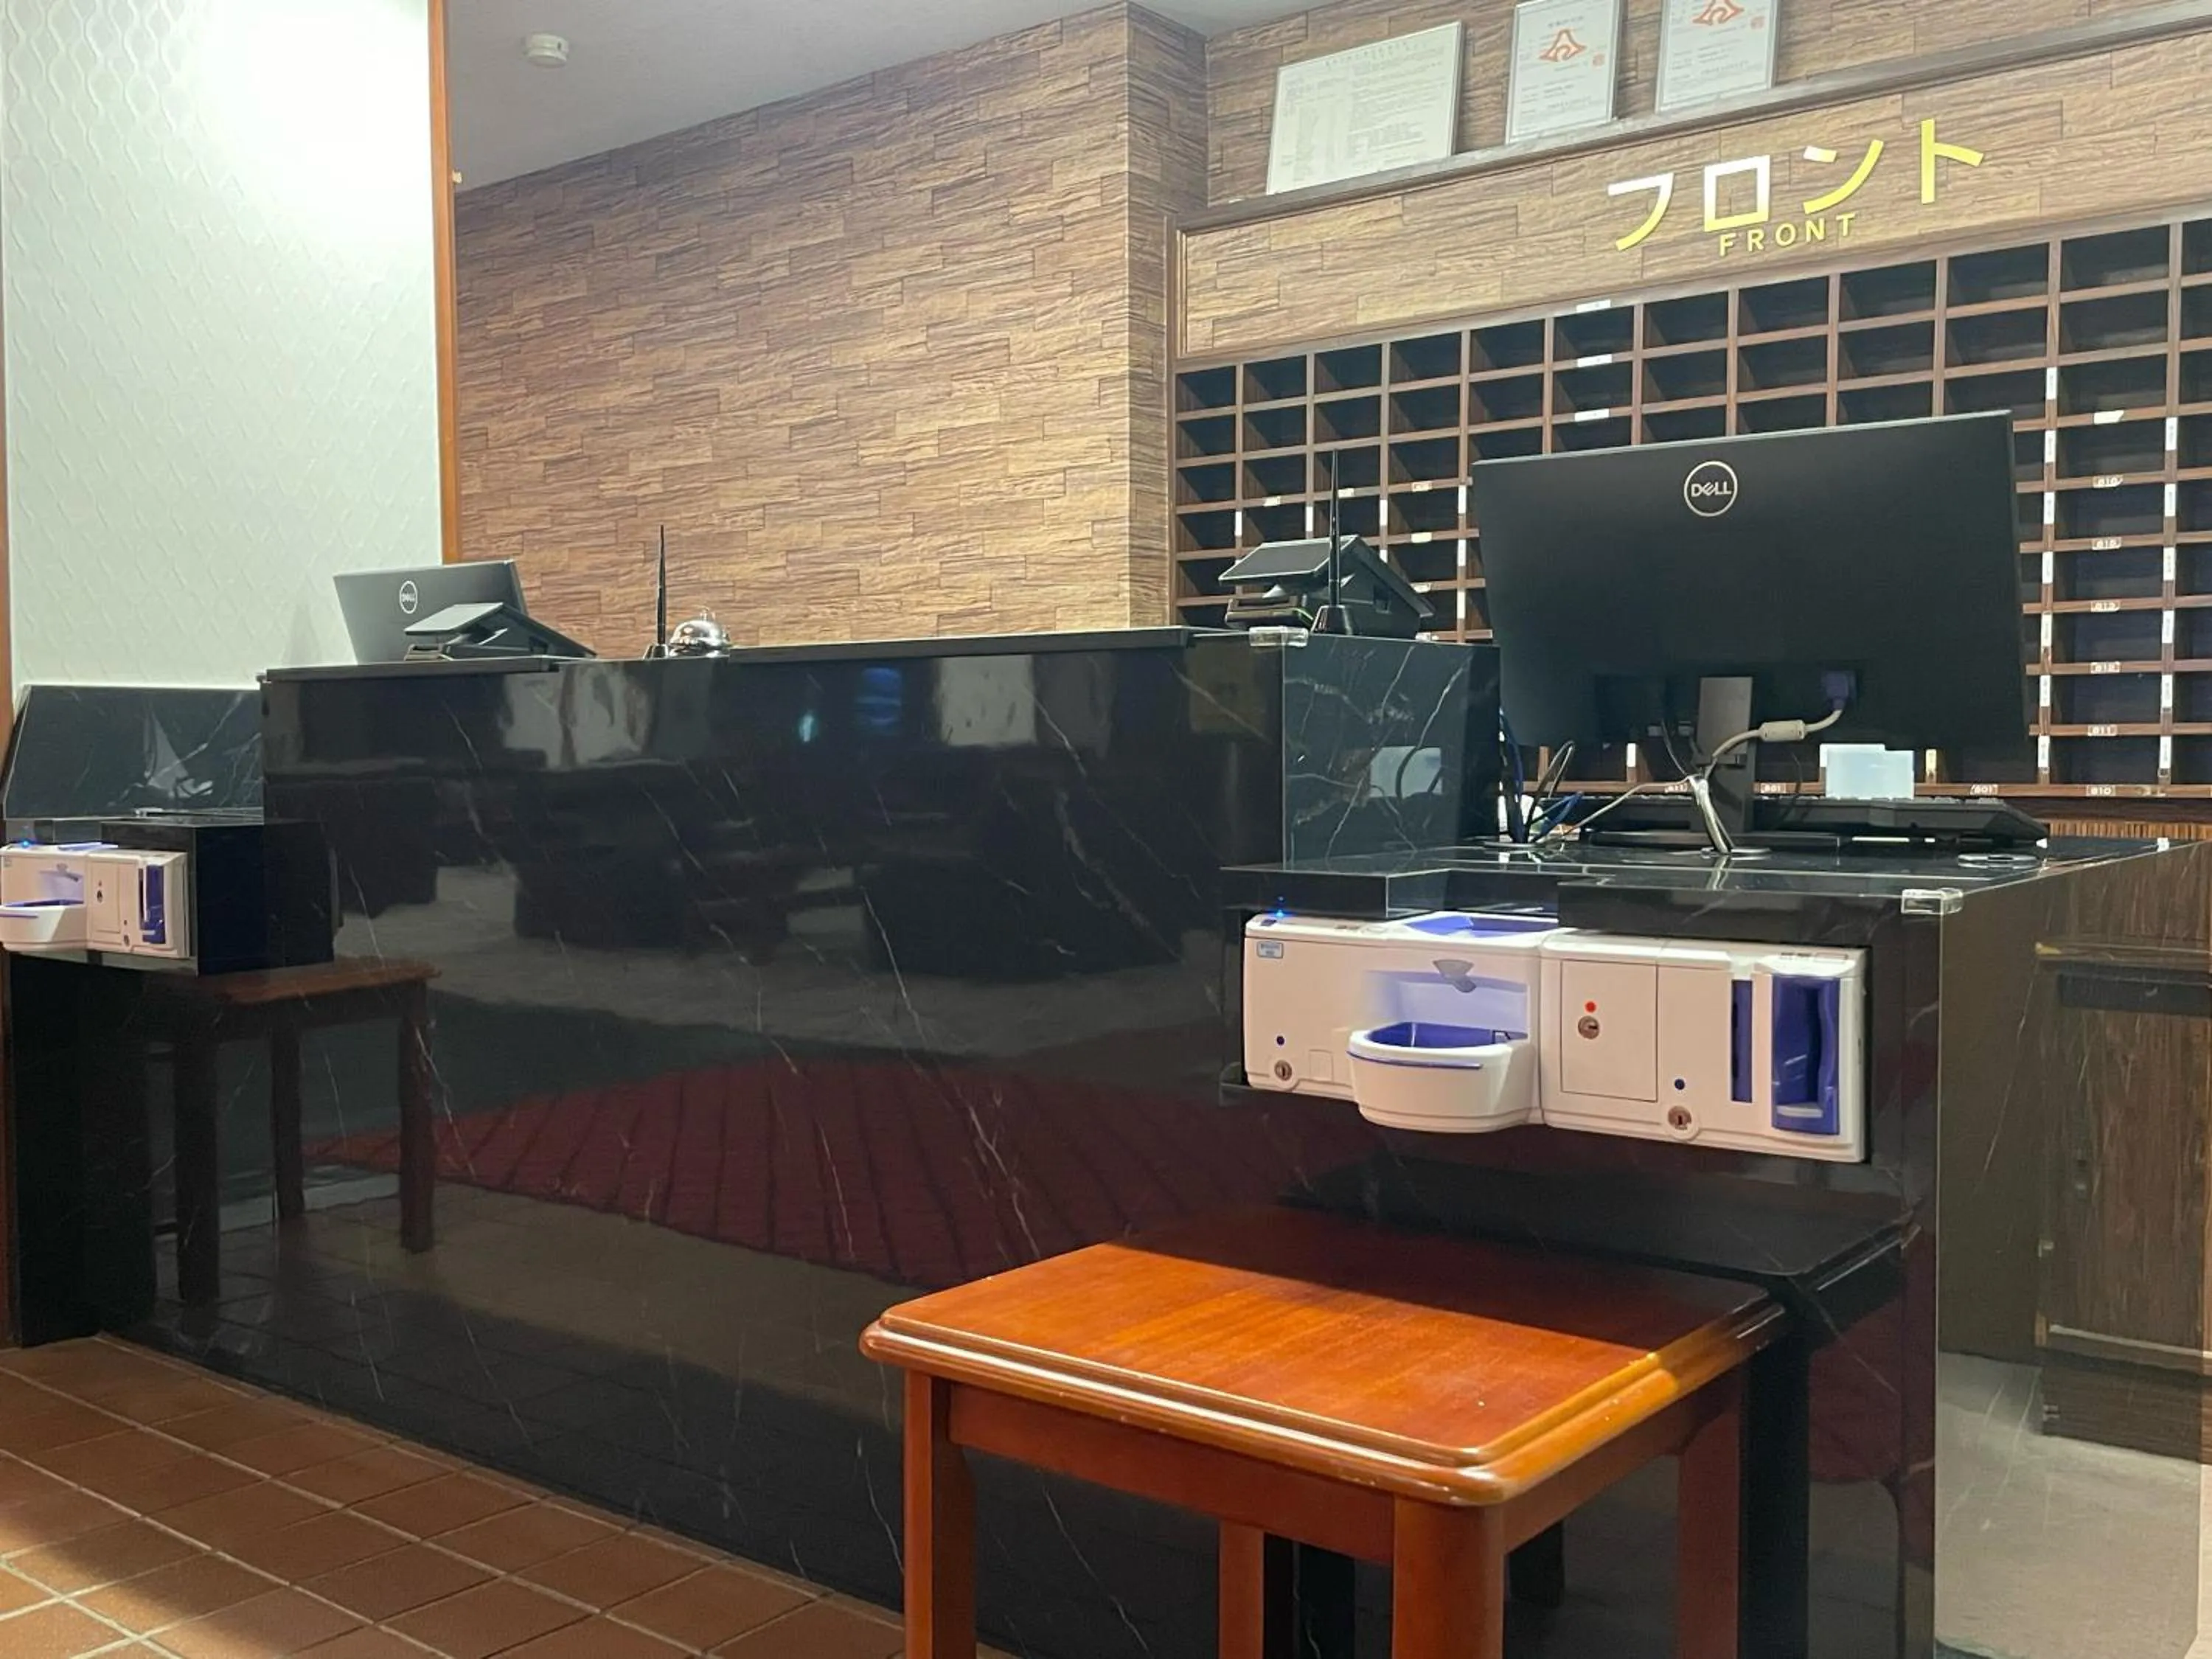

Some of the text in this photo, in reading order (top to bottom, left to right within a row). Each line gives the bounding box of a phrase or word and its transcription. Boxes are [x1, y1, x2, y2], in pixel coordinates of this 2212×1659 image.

[1607, 119, 1983, 251] フロント
[1719, 212, 1856, 257] FRONT
[1691, 481, 1732, 498] DELL
